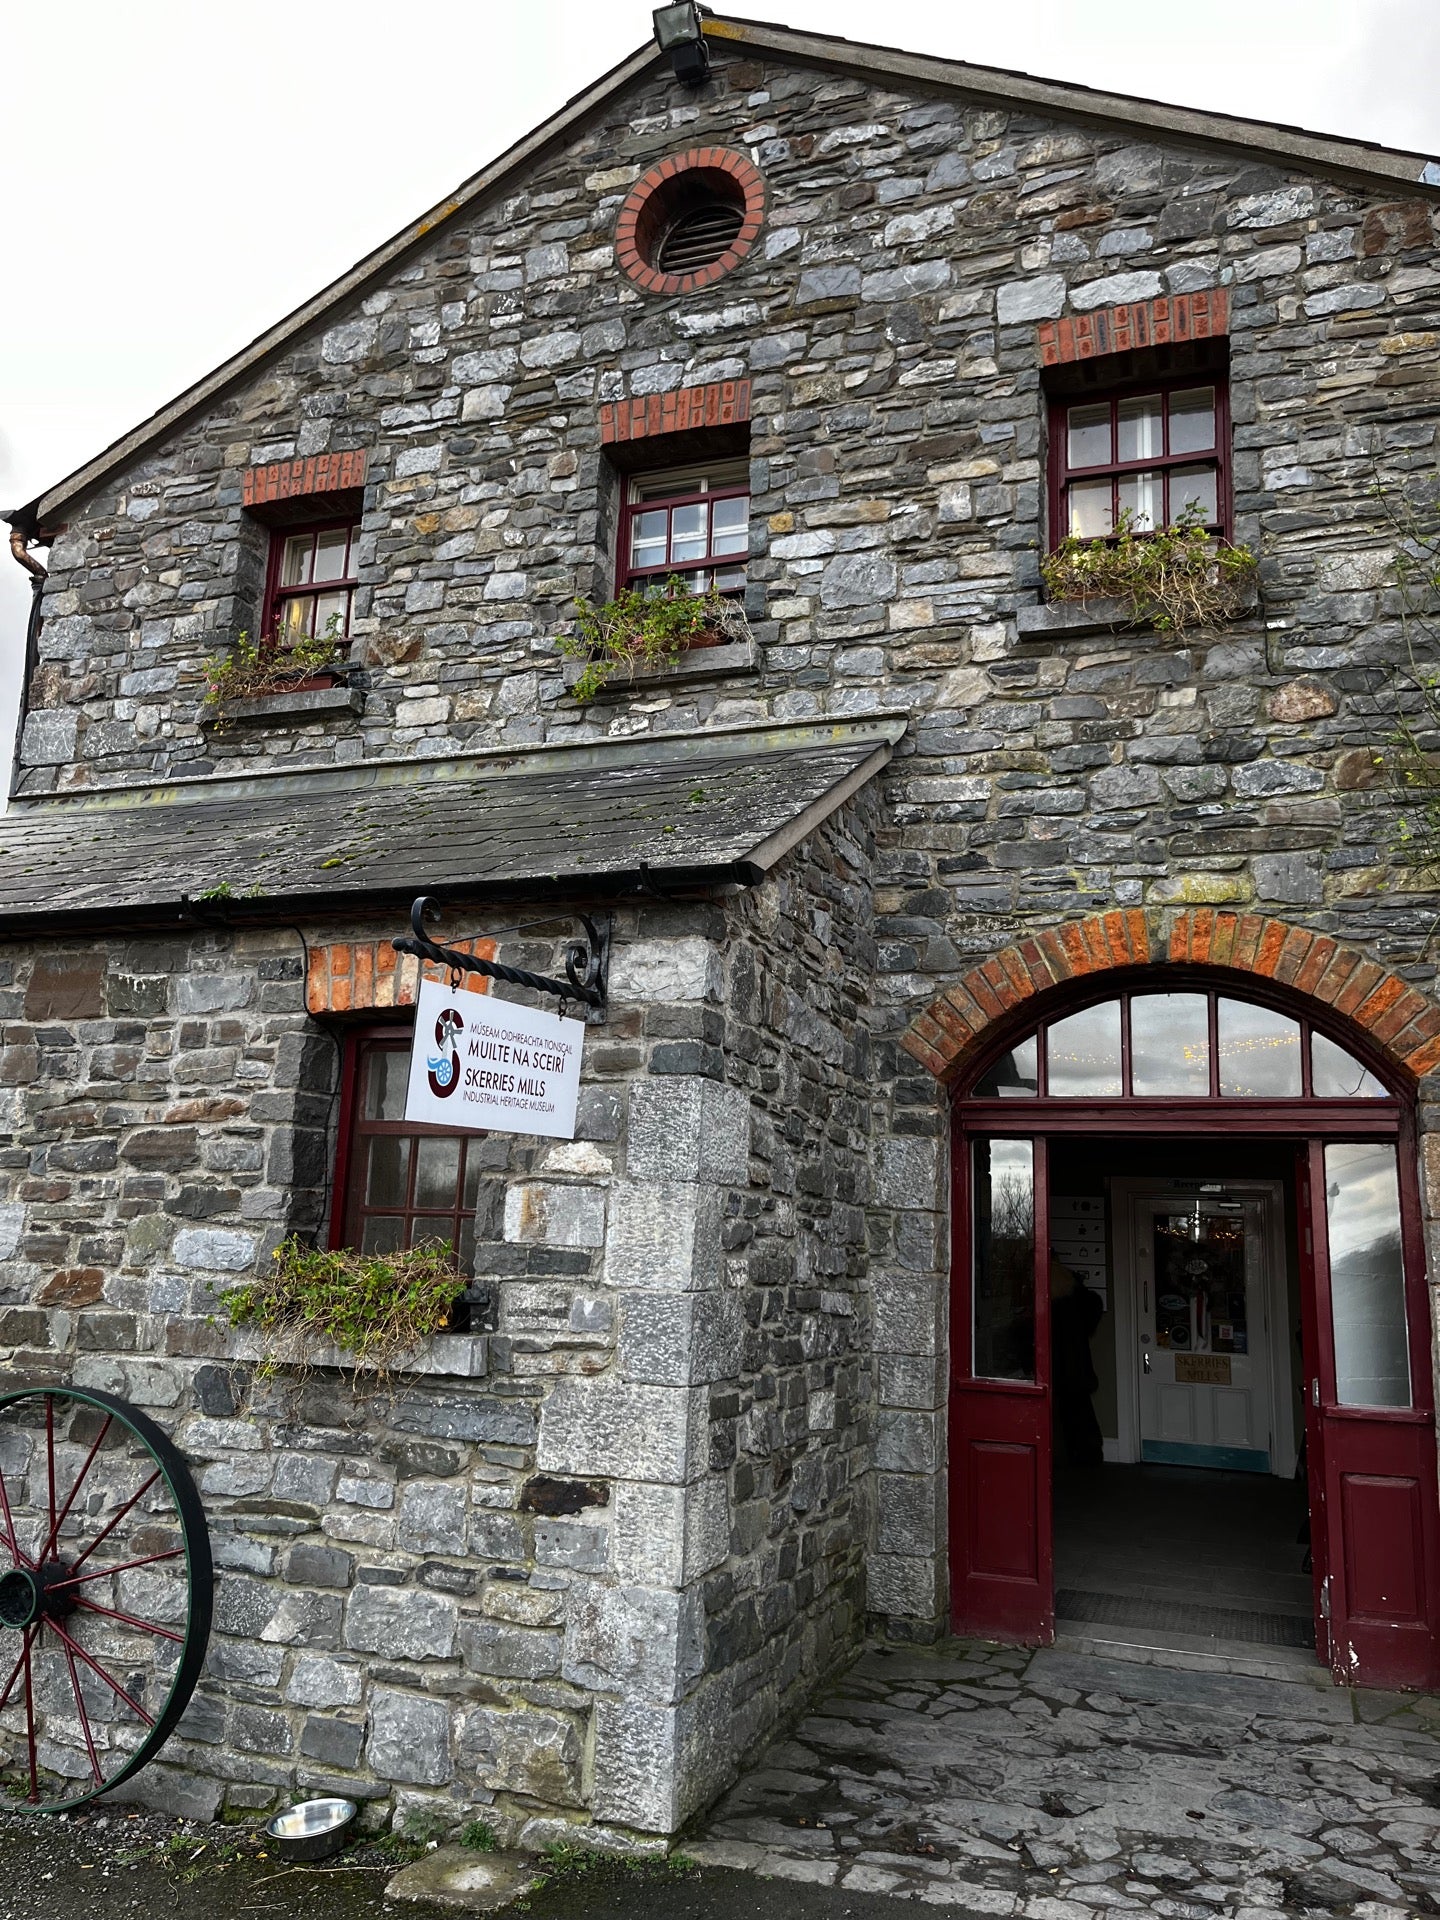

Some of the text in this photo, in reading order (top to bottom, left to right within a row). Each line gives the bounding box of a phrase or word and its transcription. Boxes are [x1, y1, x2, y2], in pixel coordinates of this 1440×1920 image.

[470, 1022, 573, 1054] MÚSEAM OIDHREACHTA TIONSCAIL
[468, 1039, 566, 1073] MUILTE NA SCEIRÍ
[465, 1068, 546, 1098] SKERRIES MILLS
[463, 1091, 555, 1113] INDUSTRIAL HERITAGE MUSEUM
[1176, 1355, 1228, 1369] SKERRIES
[1187, 1370, 1221, 1382] MILLS
